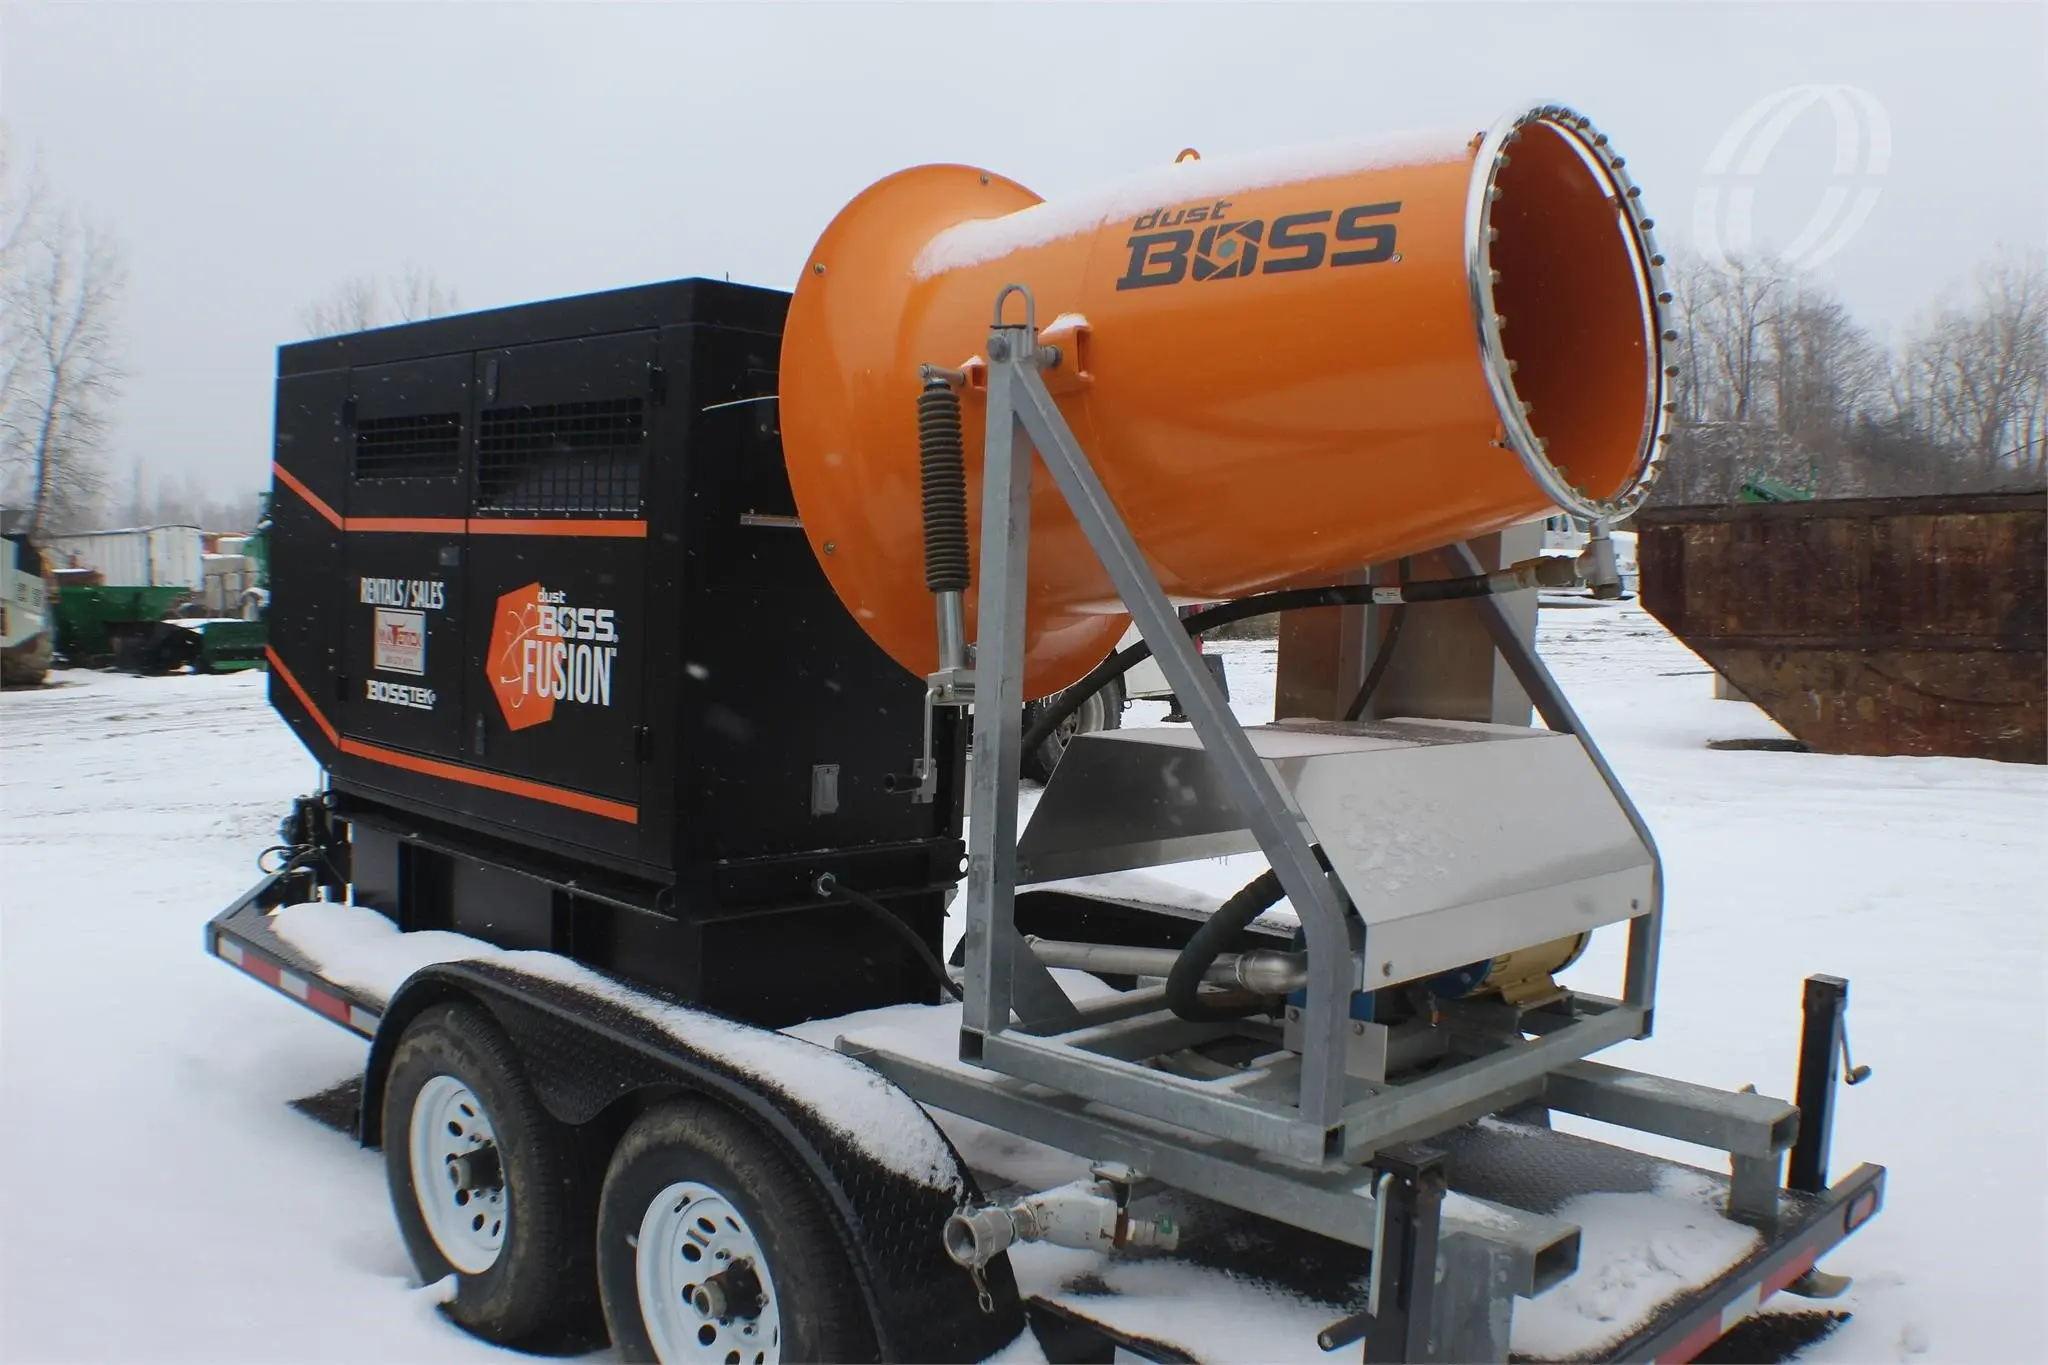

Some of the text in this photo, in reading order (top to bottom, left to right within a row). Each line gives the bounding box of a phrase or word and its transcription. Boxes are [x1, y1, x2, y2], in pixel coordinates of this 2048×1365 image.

[1133, 200, 1232, 231] dust
[1116, 201, 1401, 291] BOSS
[537, 587, 566, 604] dust
[537, 605, 615, 642] BOSS
[523, 639, 611, 706] FUSION
[366, 680, 434, 709] BOSSTEK
